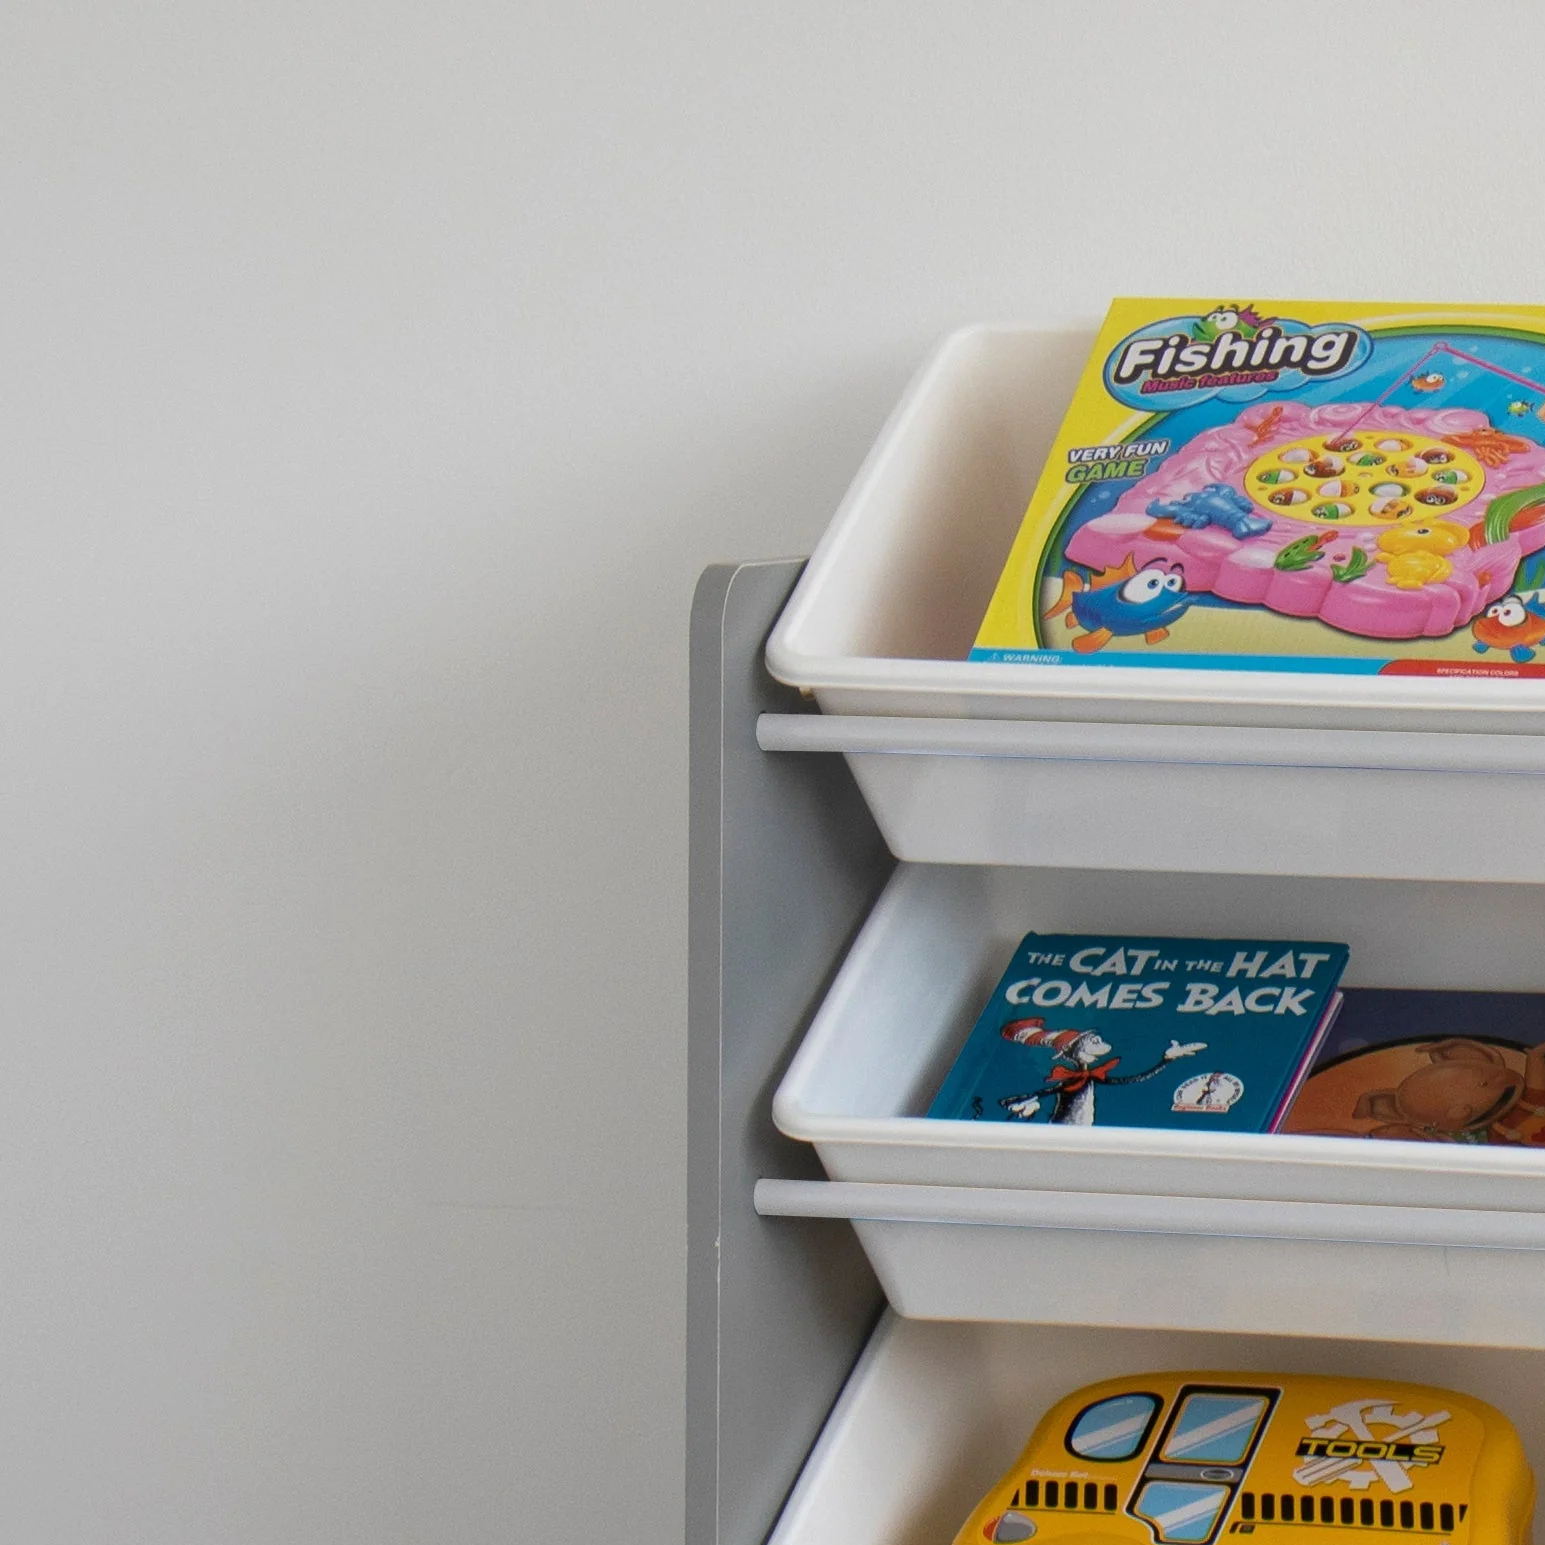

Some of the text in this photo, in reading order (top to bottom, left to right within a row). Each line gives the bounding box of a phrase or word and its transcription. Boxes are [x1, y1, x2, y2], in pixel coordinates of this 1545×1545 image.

[1117, 327, 1354, 382] Fishing
[1140, 370, 1279, 394] Music features
[1069, 440, 1168, 463] VERY FUN
[1066, 459, 1147, 483] GAME
[1027, 946, 1330, 979] THE CAT IN THE HAT
[1005, 977, 1315, 1016] COMES BACK
[1302, 1438, 1442, 1464] TOOLS
